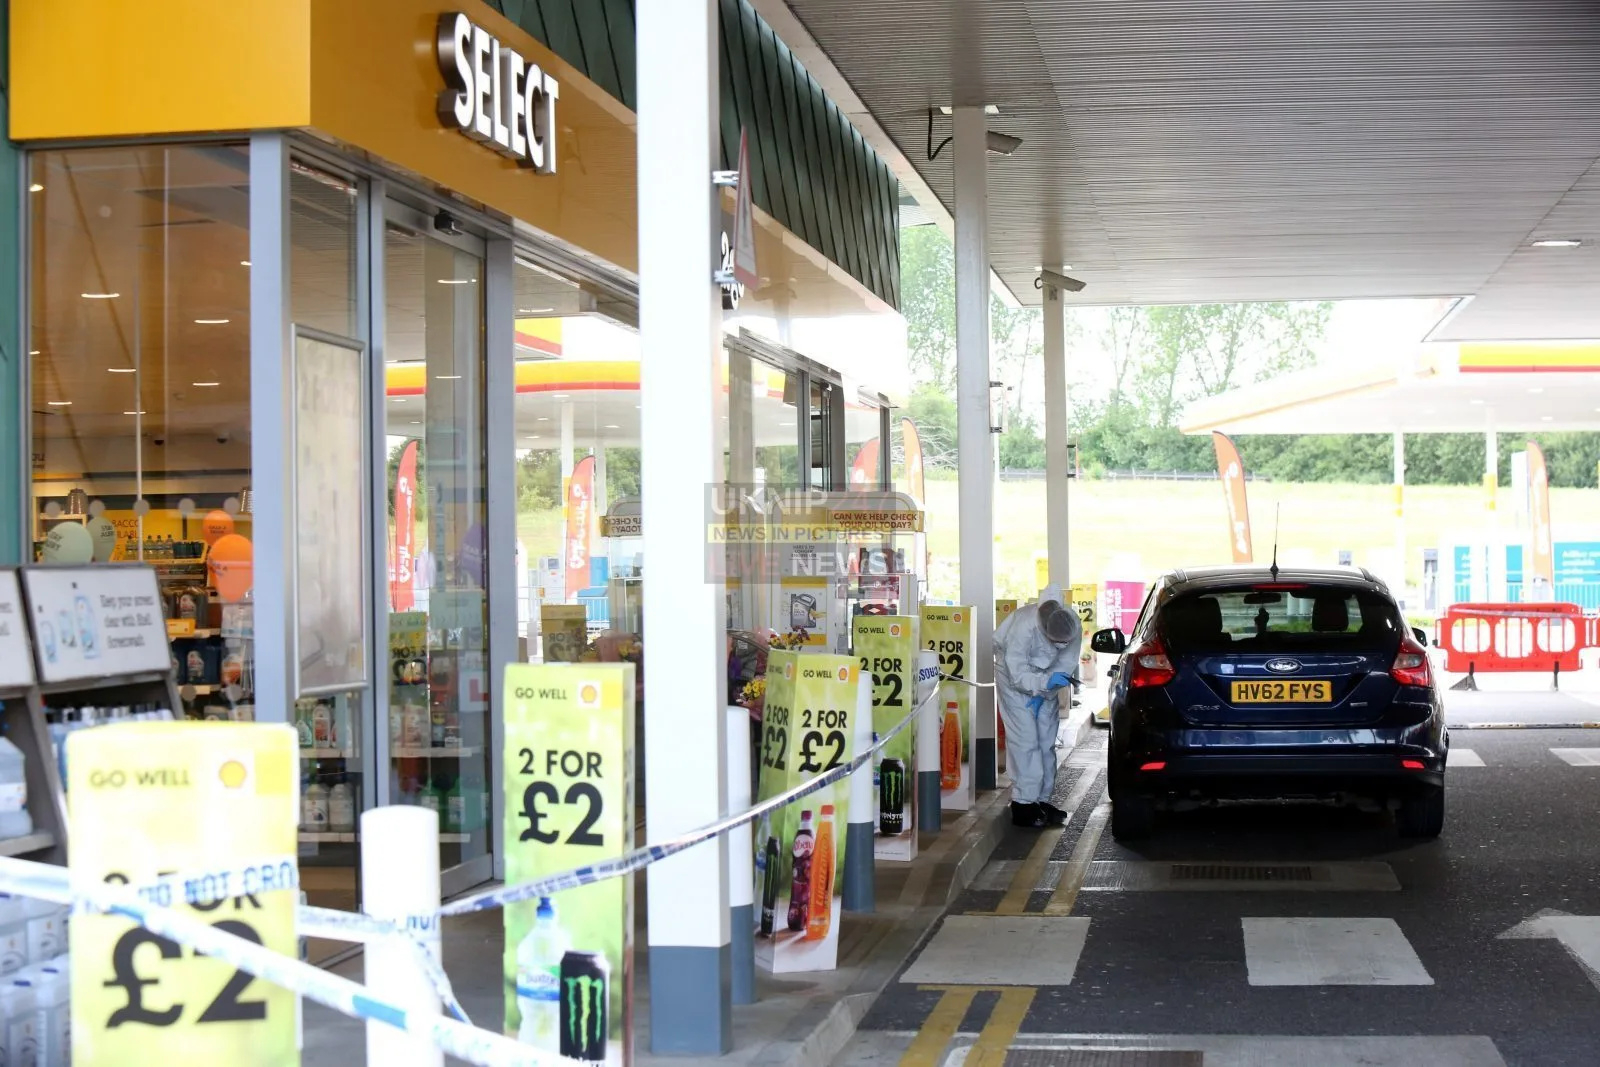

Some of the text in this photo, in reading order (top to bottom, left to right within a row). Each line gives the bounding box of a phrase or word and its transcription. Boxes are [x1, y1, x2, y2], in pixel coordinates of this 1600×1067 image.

[441, 12, 560, 174] SELECT
[833, 512, 917, 522] CAN WE HELP CHECK
[839, 521, 863, 530] YOUR
[880, 521, 912, 530] TODAY?
[927, 640, 964, 653] 2 FOR
[803, 669, 832, 679] GO WELL
[860, 657, 903, 673] 2 FOR
[515, 687, 568, 701] GO WELL
[1237, 683, 1325, 700] HV62 FYS
[766, 703, 789, 726] 2 FOR
[802, 709, 848, 728] 2 FOR
[763, 726, 787, 771] £2
[798, 730, 846, 773] £2
[518, 748, 603, 778] 2 FOR
[89, 767, 191, 788] GO WELL
[518, 781, 604, 847] £2
[103, 919, 267, 1029] £2
